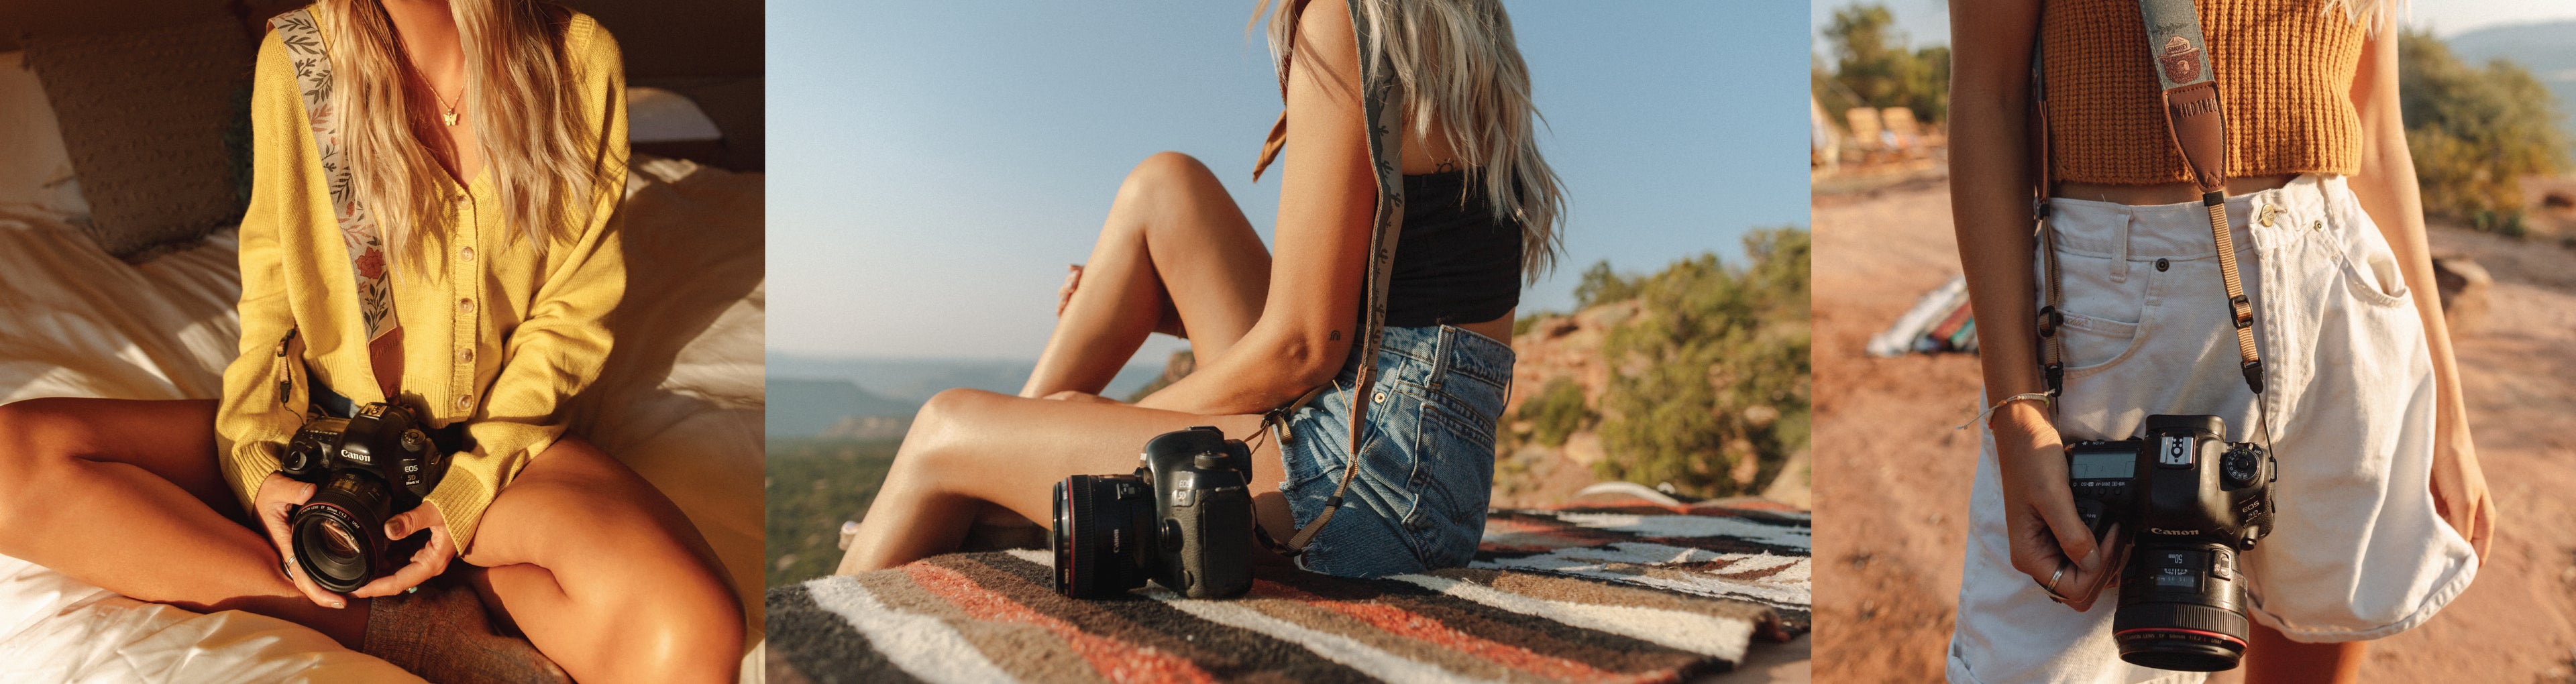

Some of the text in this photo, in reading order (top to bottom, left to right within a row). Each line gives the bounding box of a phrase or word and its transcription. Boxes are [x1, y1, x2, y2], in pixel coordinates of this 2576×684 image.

[2168, 44, 2188, 52] SMOKEY
[341, 449, 370, 462] Canon
[405, 465, 419, 473] EOS
[2243, 500, 2259, 513] EOS
[352, 520, 360, 529] USM
[2168, 554, 2183, 564] 50mm
